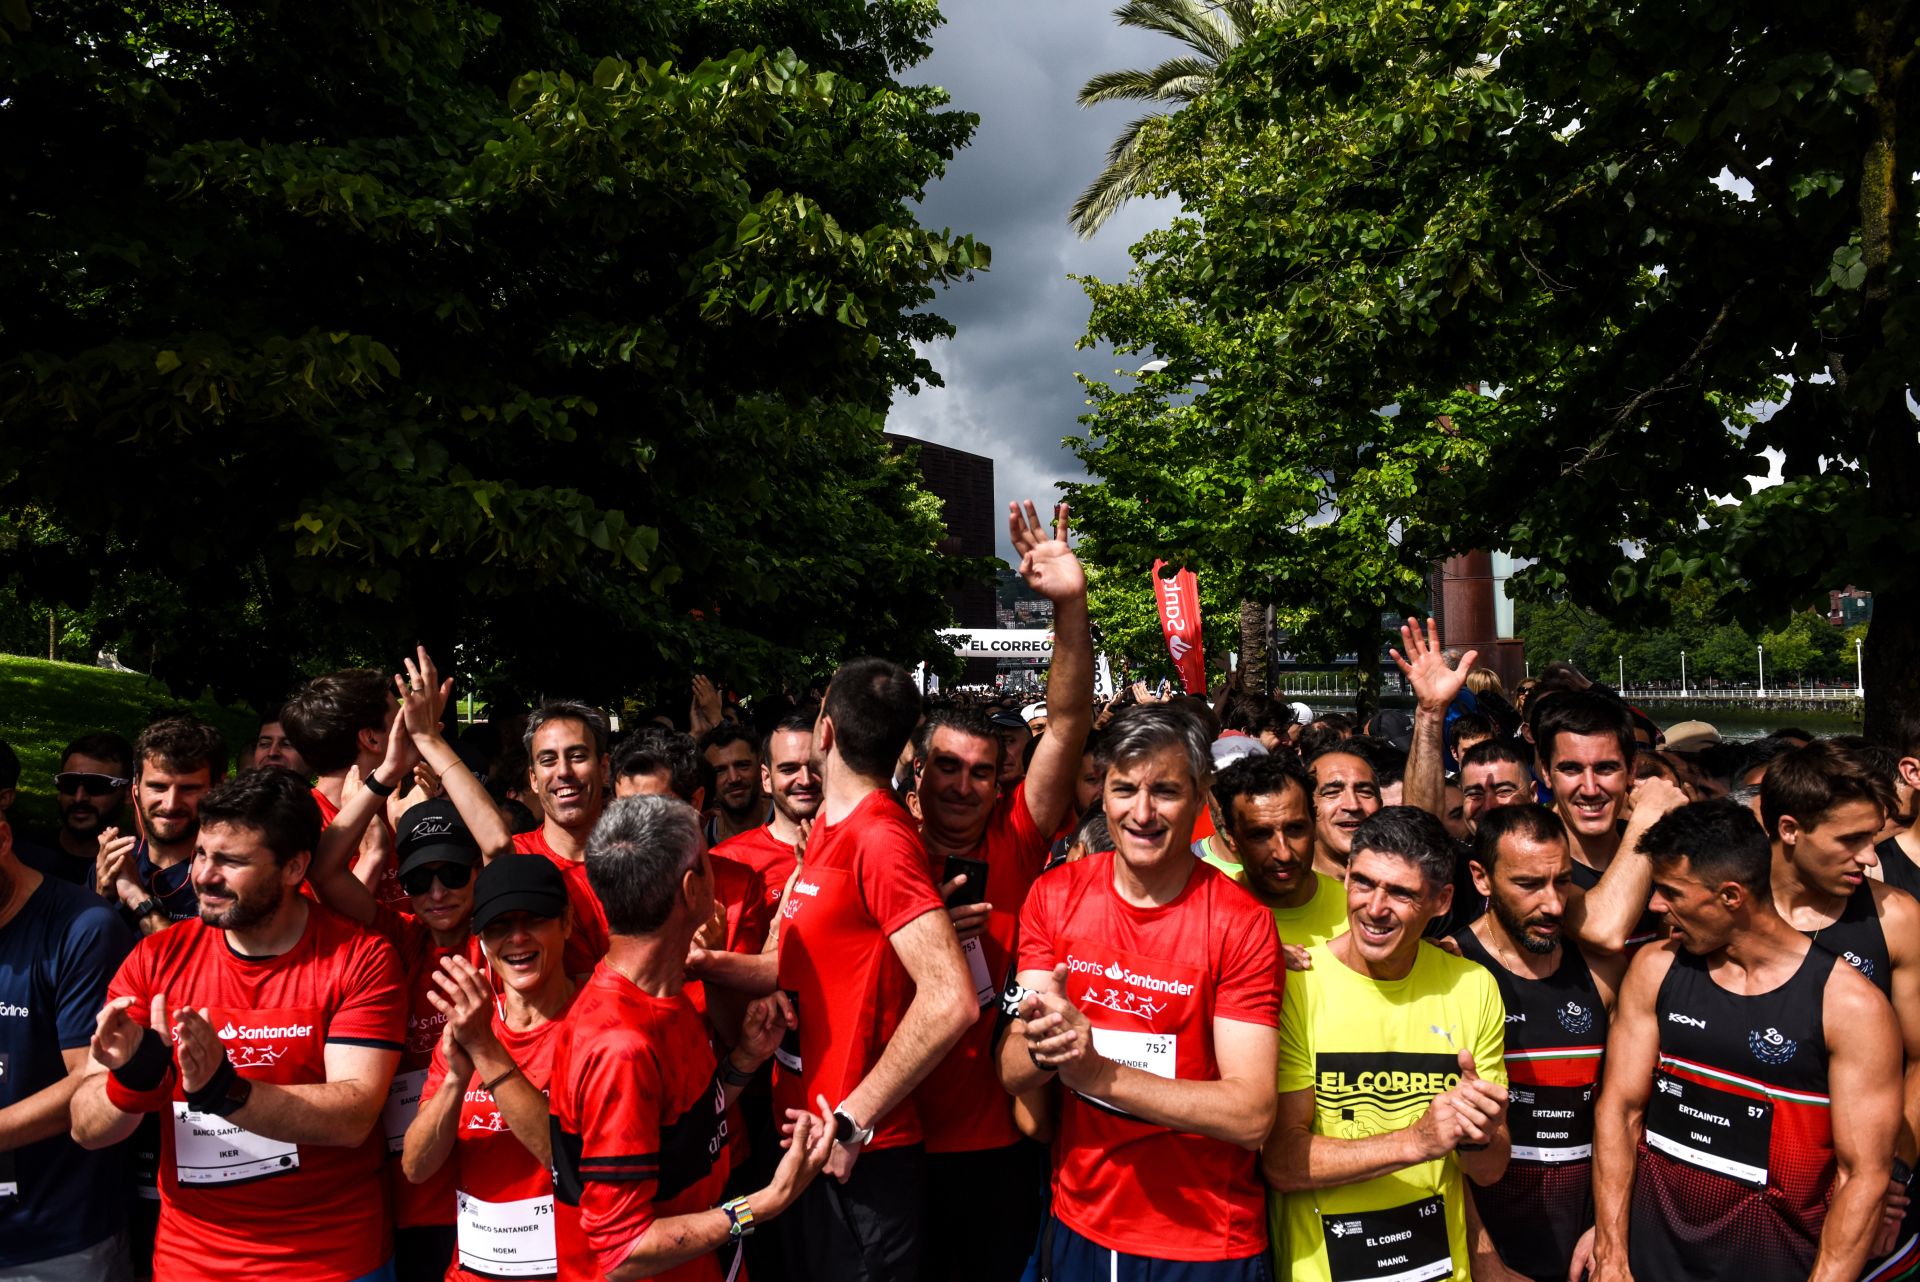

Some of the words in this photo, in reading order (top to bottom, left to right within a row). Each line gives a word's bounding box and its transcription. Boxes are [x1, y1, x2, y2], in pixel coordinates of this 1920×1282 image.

[970, 640, 989, 651] EL
[990, 640, 1051, 652] CORREO
[962, 941, 976, 953] 753
[1066, 954, 1104, 976] Sports
[1122, 968, 1194, 996] Santander
[238, 1023, 313, 1040] Santander
[1145, 1042, 1167, 1054] 752
[1108, 1058, 1149, 1069] NTANDER
[1321, 1071, 1354, 1093] EL
[1357, 1071, 1462, 1093] CORREO
[464, 1089, 488, 1102] orts
[1583, 1091, 1591, 1101] 57
[1678, 1103, 1731, 1128] ERTZAINTZA
[1748, 1106, 1764, 1119] 57
[1536, 1131, 1569, 1139] EDUARDO
[1690, 1131, 1712, 1145] UNAI
[219, 1149, 239, 1158] IKER
[533, 1203, 554, 1216] 751
[1418, 1203, 1438, 1218] 163
[471, 1221, 492, 1233] BANCO
[493, 1224, 539, 1234] SANTANDER
[1366, 1238, 1379, 1247] EL
[1379, 1230, 1413, 1245] CORREO
[492, 1247, 518, 1255] NOEMI
[1377, 1254, 1409, 1268] IMANOL
